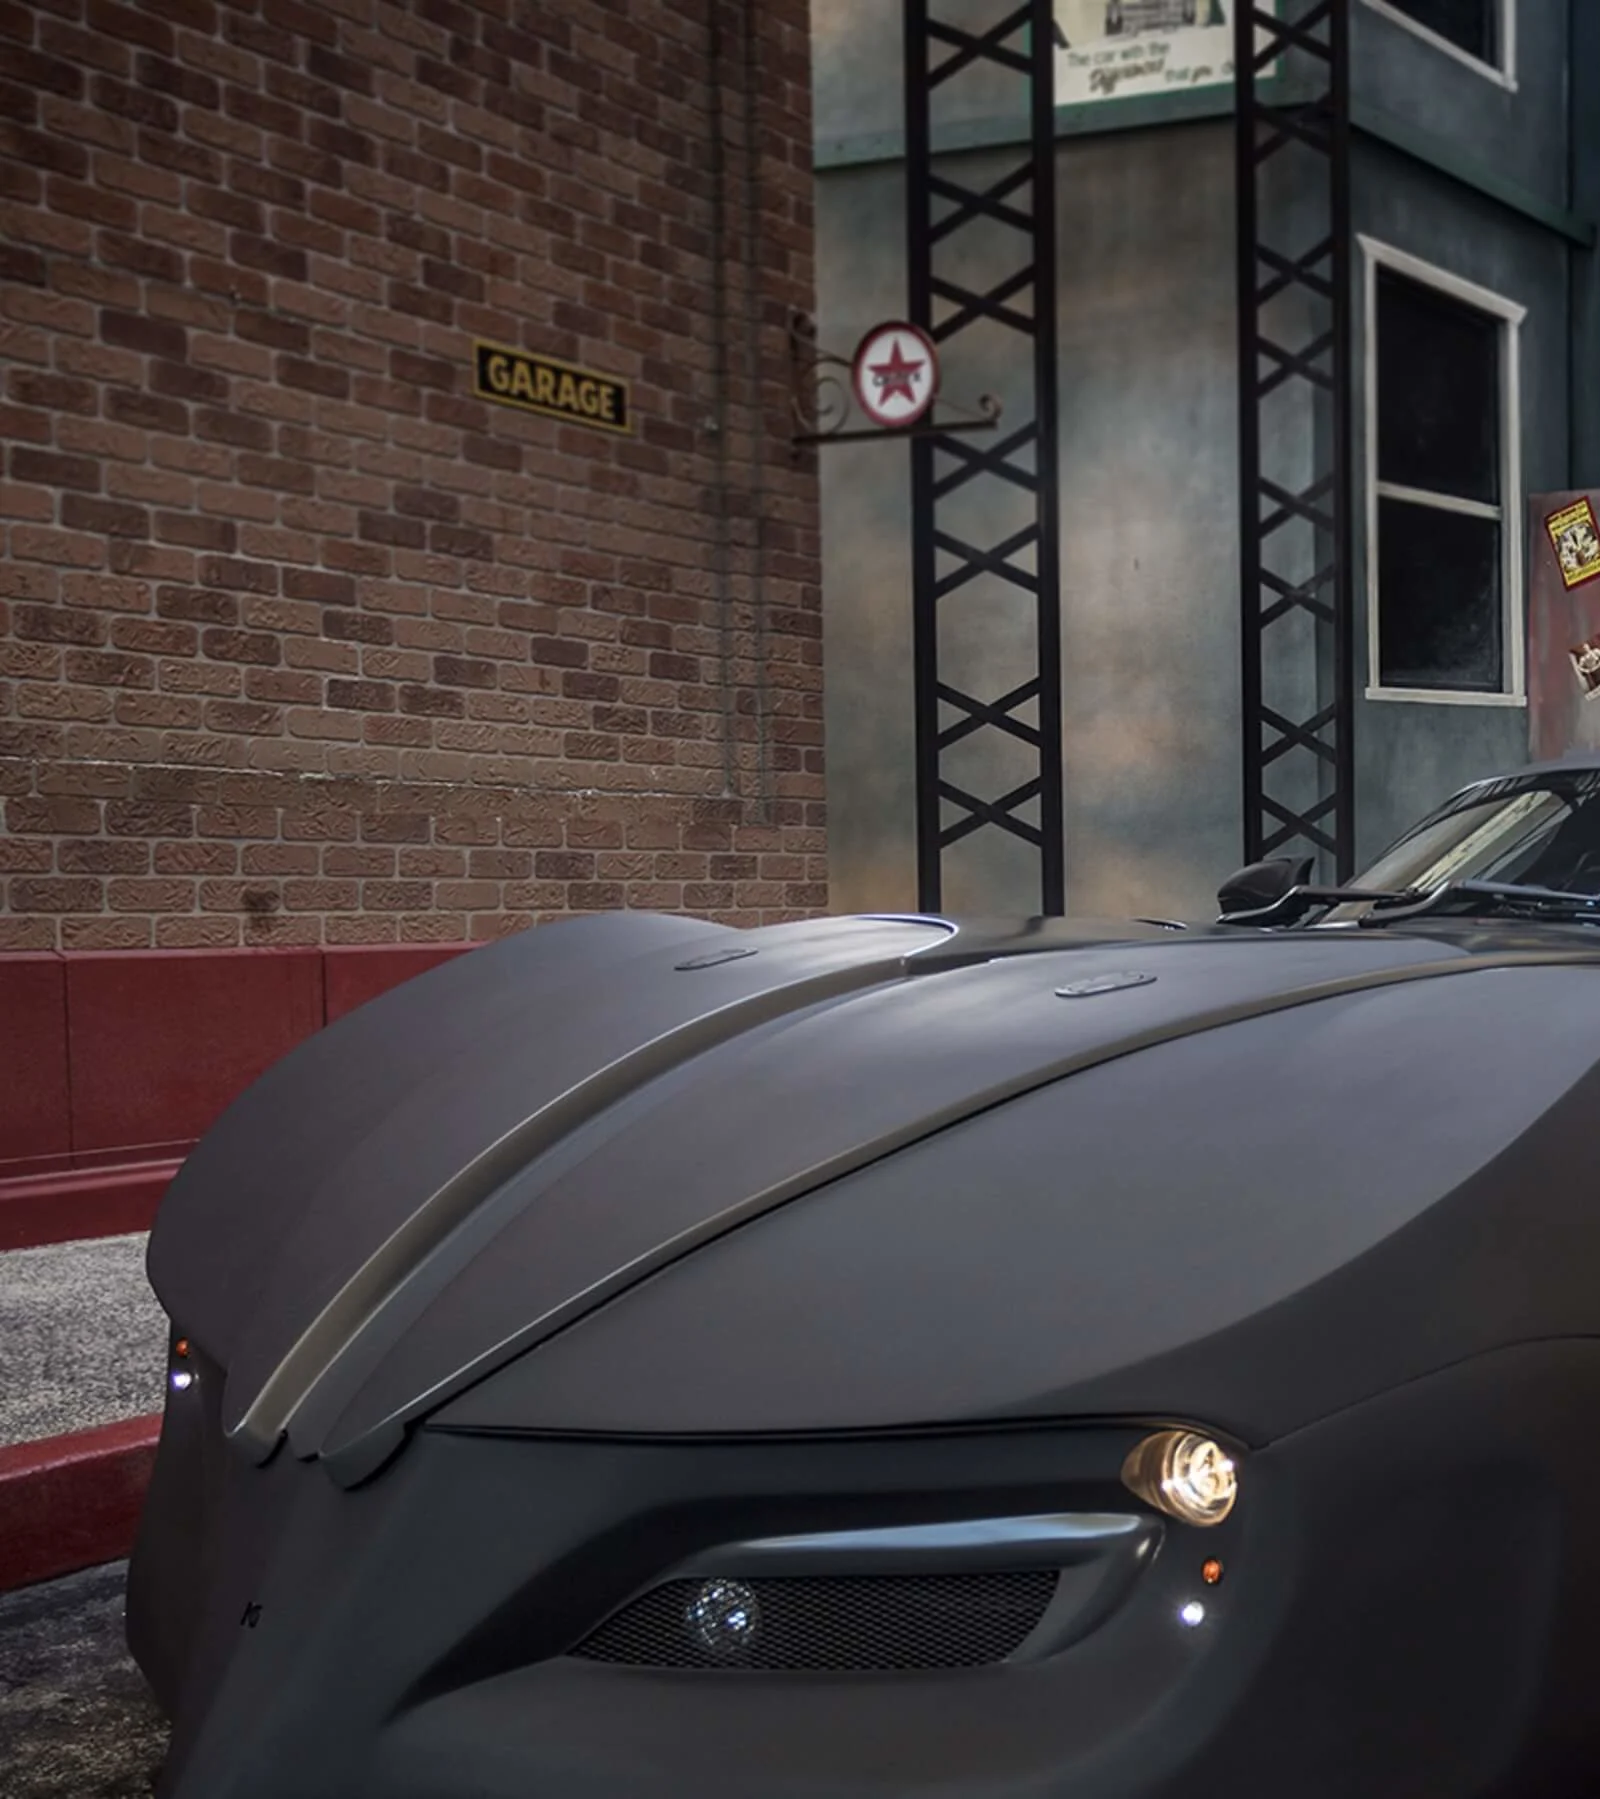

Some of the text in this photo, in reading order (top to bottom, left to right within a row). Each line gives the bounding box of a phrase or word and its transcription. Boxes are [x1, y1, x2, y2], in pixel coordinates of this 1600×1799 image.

[1067, 41, 1170, 66] The car with the
[487, 354, 616, 420] GARAGE
